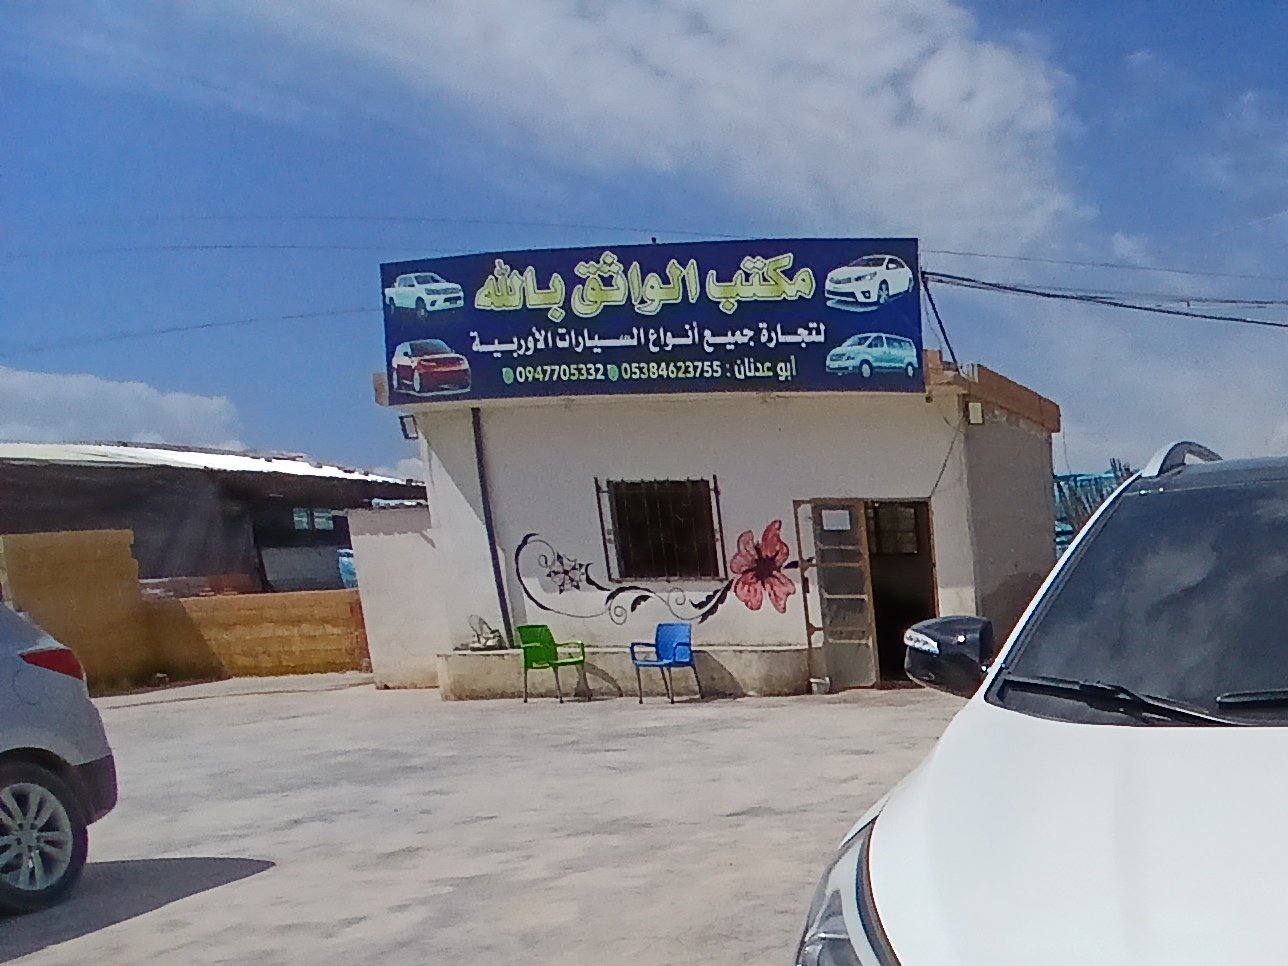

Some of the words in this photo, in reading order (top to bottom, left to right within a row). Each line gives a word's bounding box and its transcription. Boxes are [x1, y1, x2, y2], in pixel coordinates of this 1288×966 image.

[475, 259, 566, 322] بالله
[571, 251, 700, 317] الواثق
[705, 253, 816, 314] مكتب
[555, 326, 645, 353] السيارات
[648, 321, 699, 352] أنواع
[703, 328, 755, 352] جميع
[758, 322, 826, 348] لتجارة
[516, 364, 605, 382] 0947705332
[621, 361, 722, 379] 05384623755
